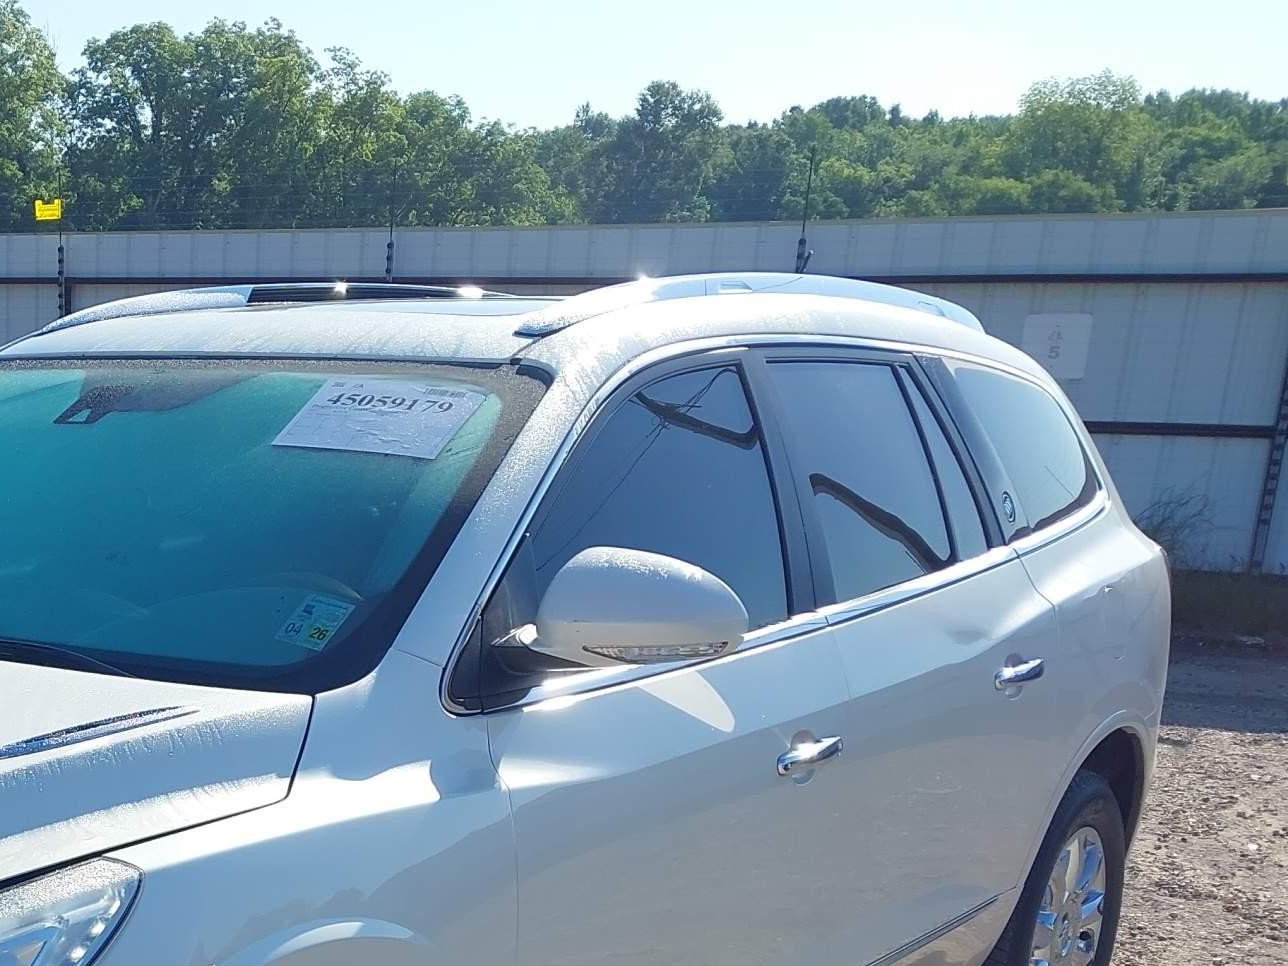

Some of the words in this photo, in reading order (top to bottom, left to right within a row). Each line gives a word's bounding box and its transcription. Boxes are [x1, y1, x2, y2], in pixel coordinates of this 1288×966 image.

[1048, 346, 1060, 359] 5
[327, 392, 454, 414] 45059179
[285, 622, 303, 635] 04
[309, 627, 329, 640] 26
